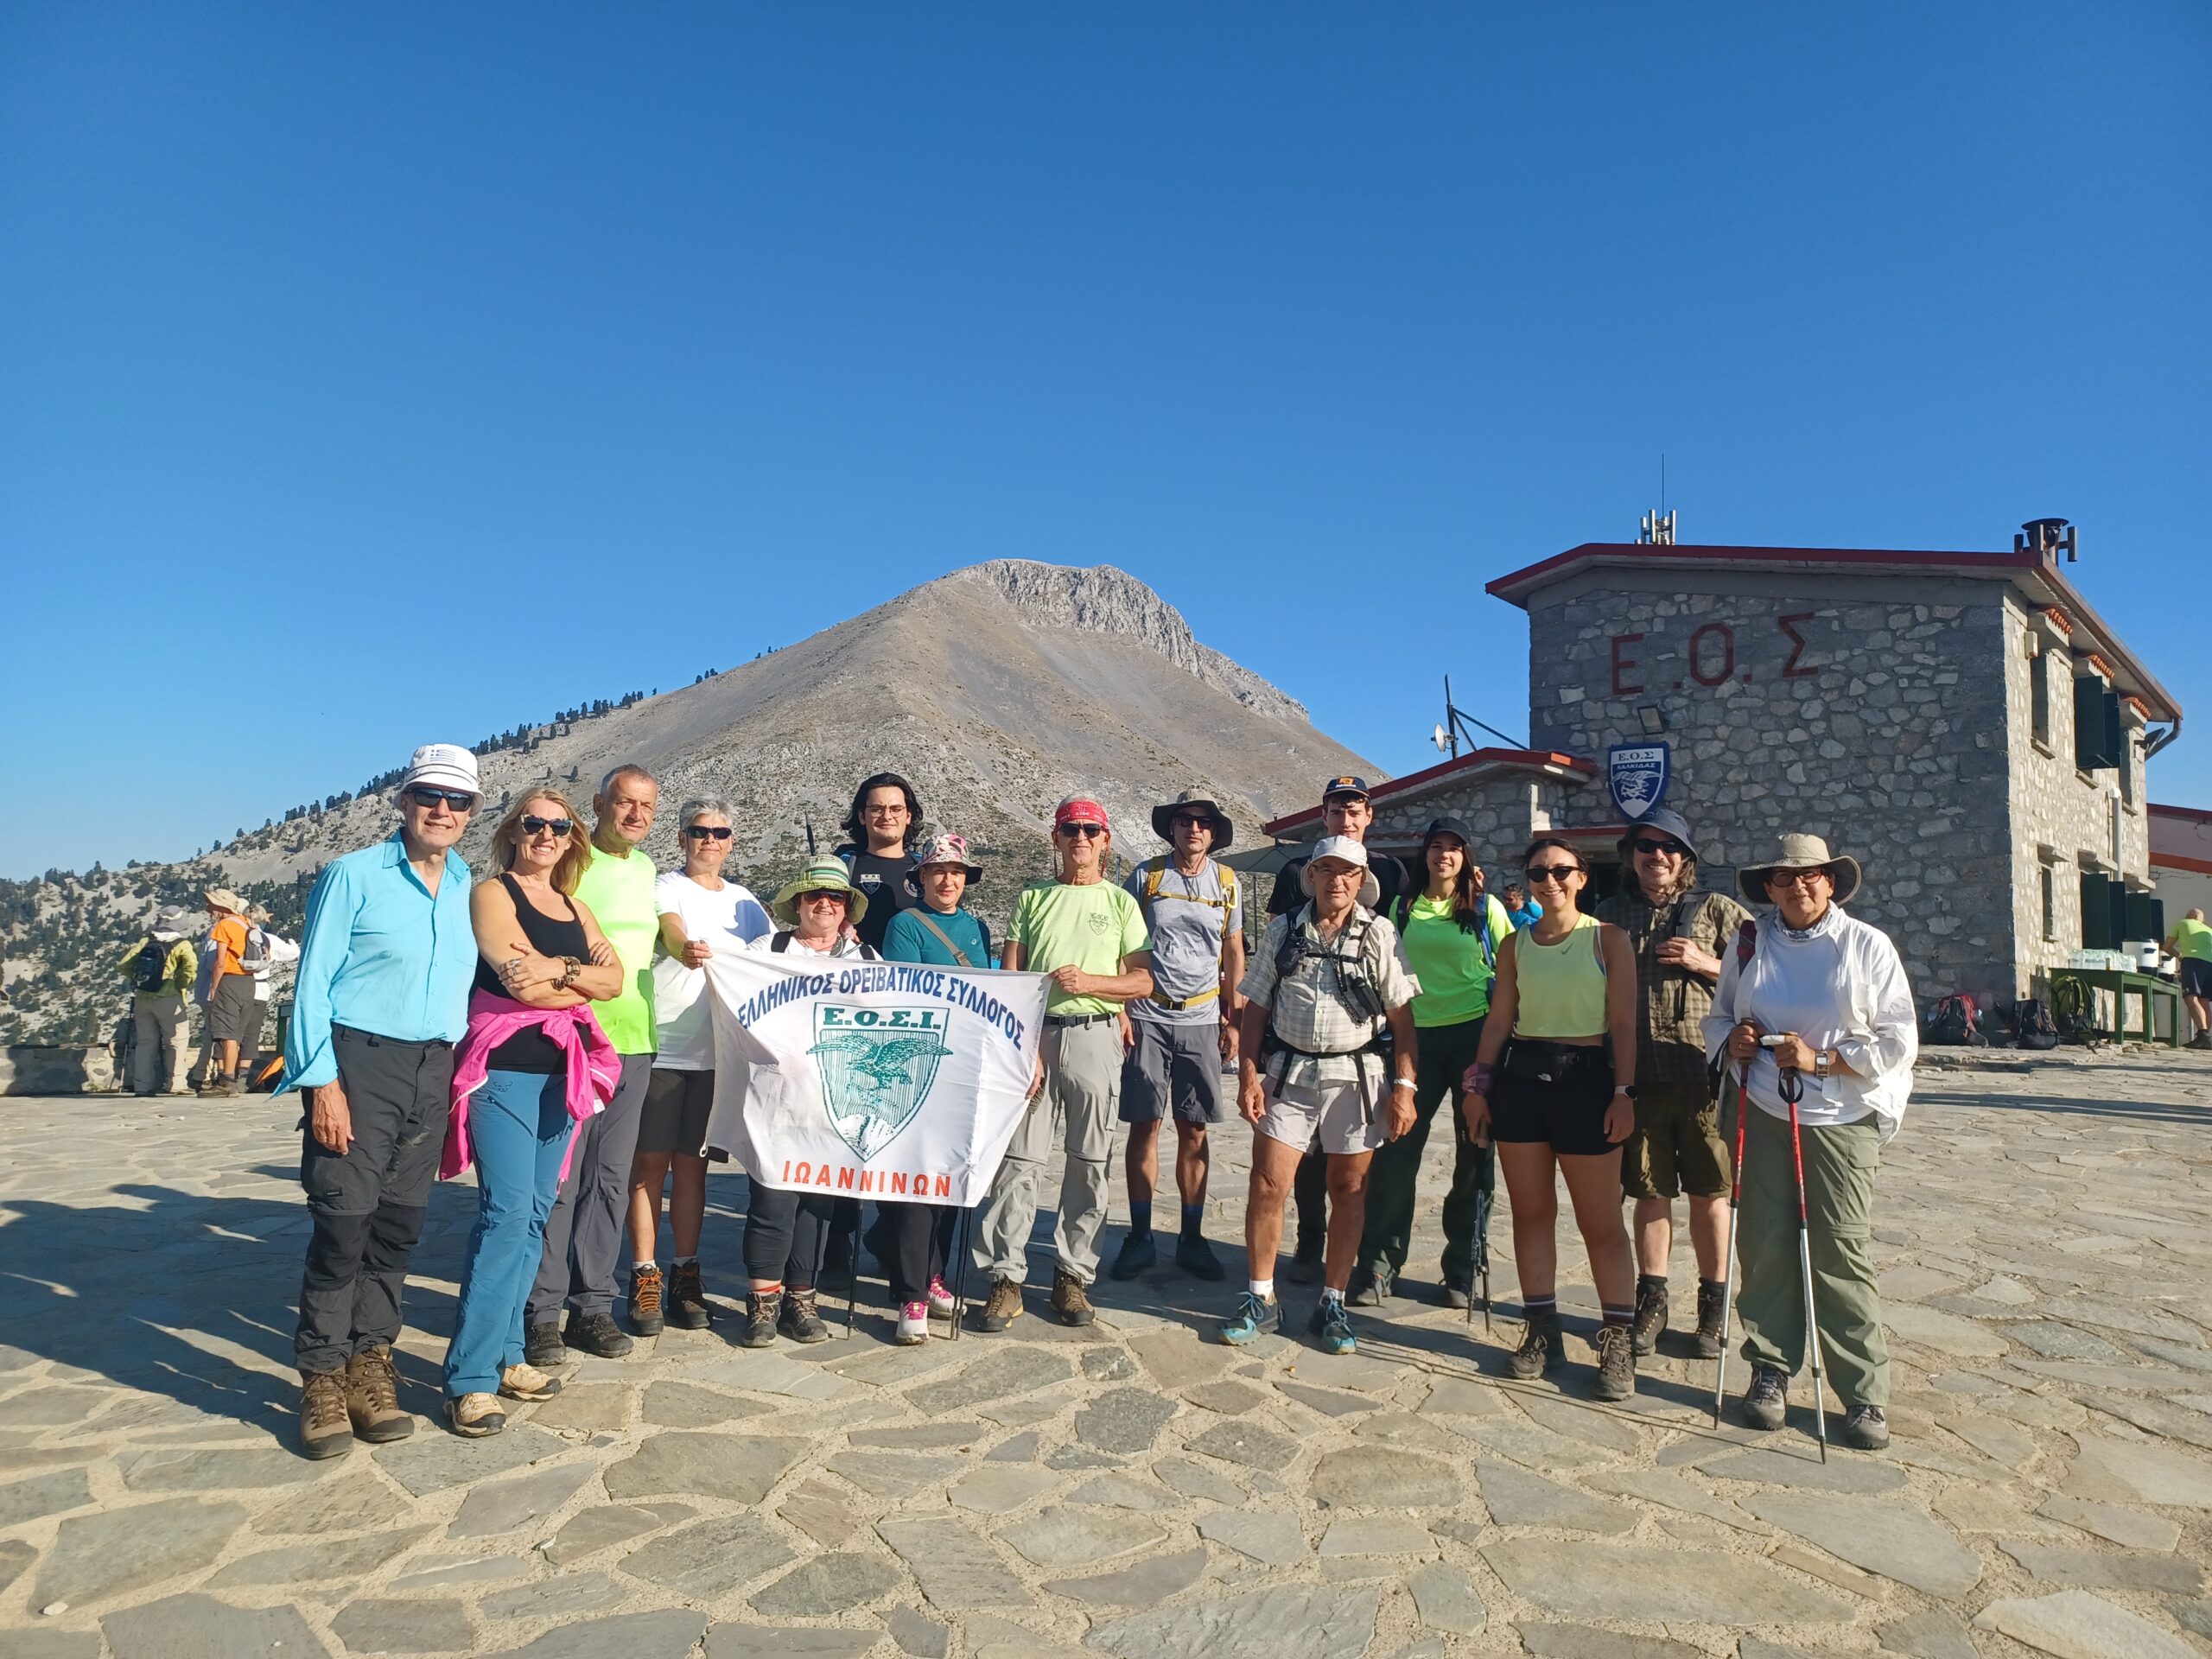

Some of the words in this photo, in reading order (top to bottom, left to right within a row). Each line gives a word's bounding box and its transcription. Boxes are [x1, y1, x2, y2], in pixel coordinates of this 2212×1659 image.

[1618, 751, 1654, 761] Ε.Ο.Σ
[738, 973, 835, 1029] ΕΛΛΗΝΙΚΟΣ
[839, 967, 945, 998] ΟΡΕΙΒΑΤΙΚΟΣ
[946, 976, 1025, 1052] ΣΥΛΛΟΓΟΣ
[823, 1007, 942, 1030] Ε.Ο.Σ.Ι.
[782, 1160, 951, 1198] ΙΩΑΝΝΙΝΩΝ
